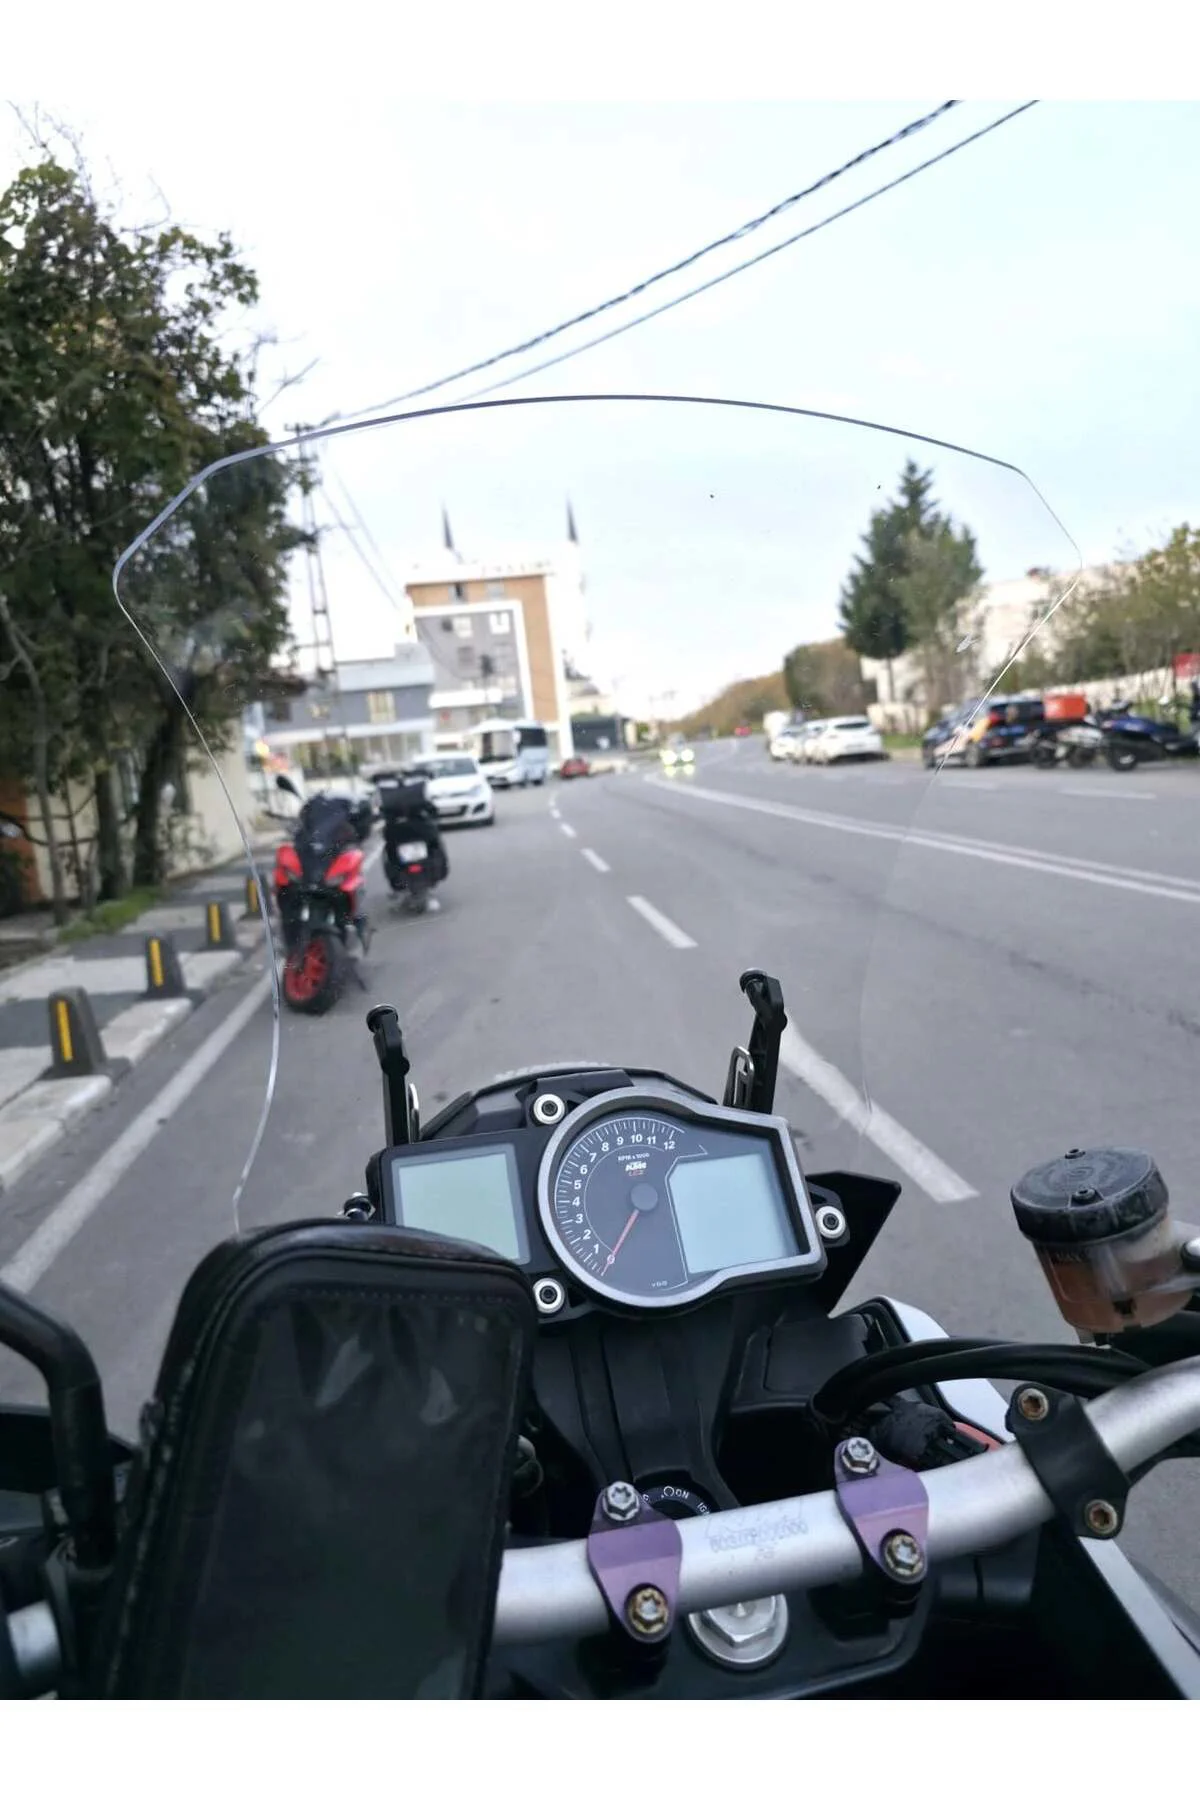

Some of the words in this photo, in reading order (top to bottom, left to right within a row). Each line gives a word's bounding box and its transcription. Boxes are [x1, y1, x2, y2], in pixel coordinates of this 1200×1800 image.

[616, 1136, 624, 1145] 9
[631, 1133, 643, 1144] 10
[646, 1135, 656, 1145] 11
[601, 1142, 609, 1152] 8
[663, 1140, 676, 1150] 12
[589, 1152, 597, 1162] 7
[580, 1165, 588, 1175] 6
[573, 1179, 582, 1190] 5
[572, 1196, 580, 1207] 4
[575, 1213, 583, 1224] 3
[582, 1229, 591, 1240] 2
[593, 1243, 599, 1254] 1
[607, 1254, 615, 1264] 0
[675, 1488, 690, 1499] ON
